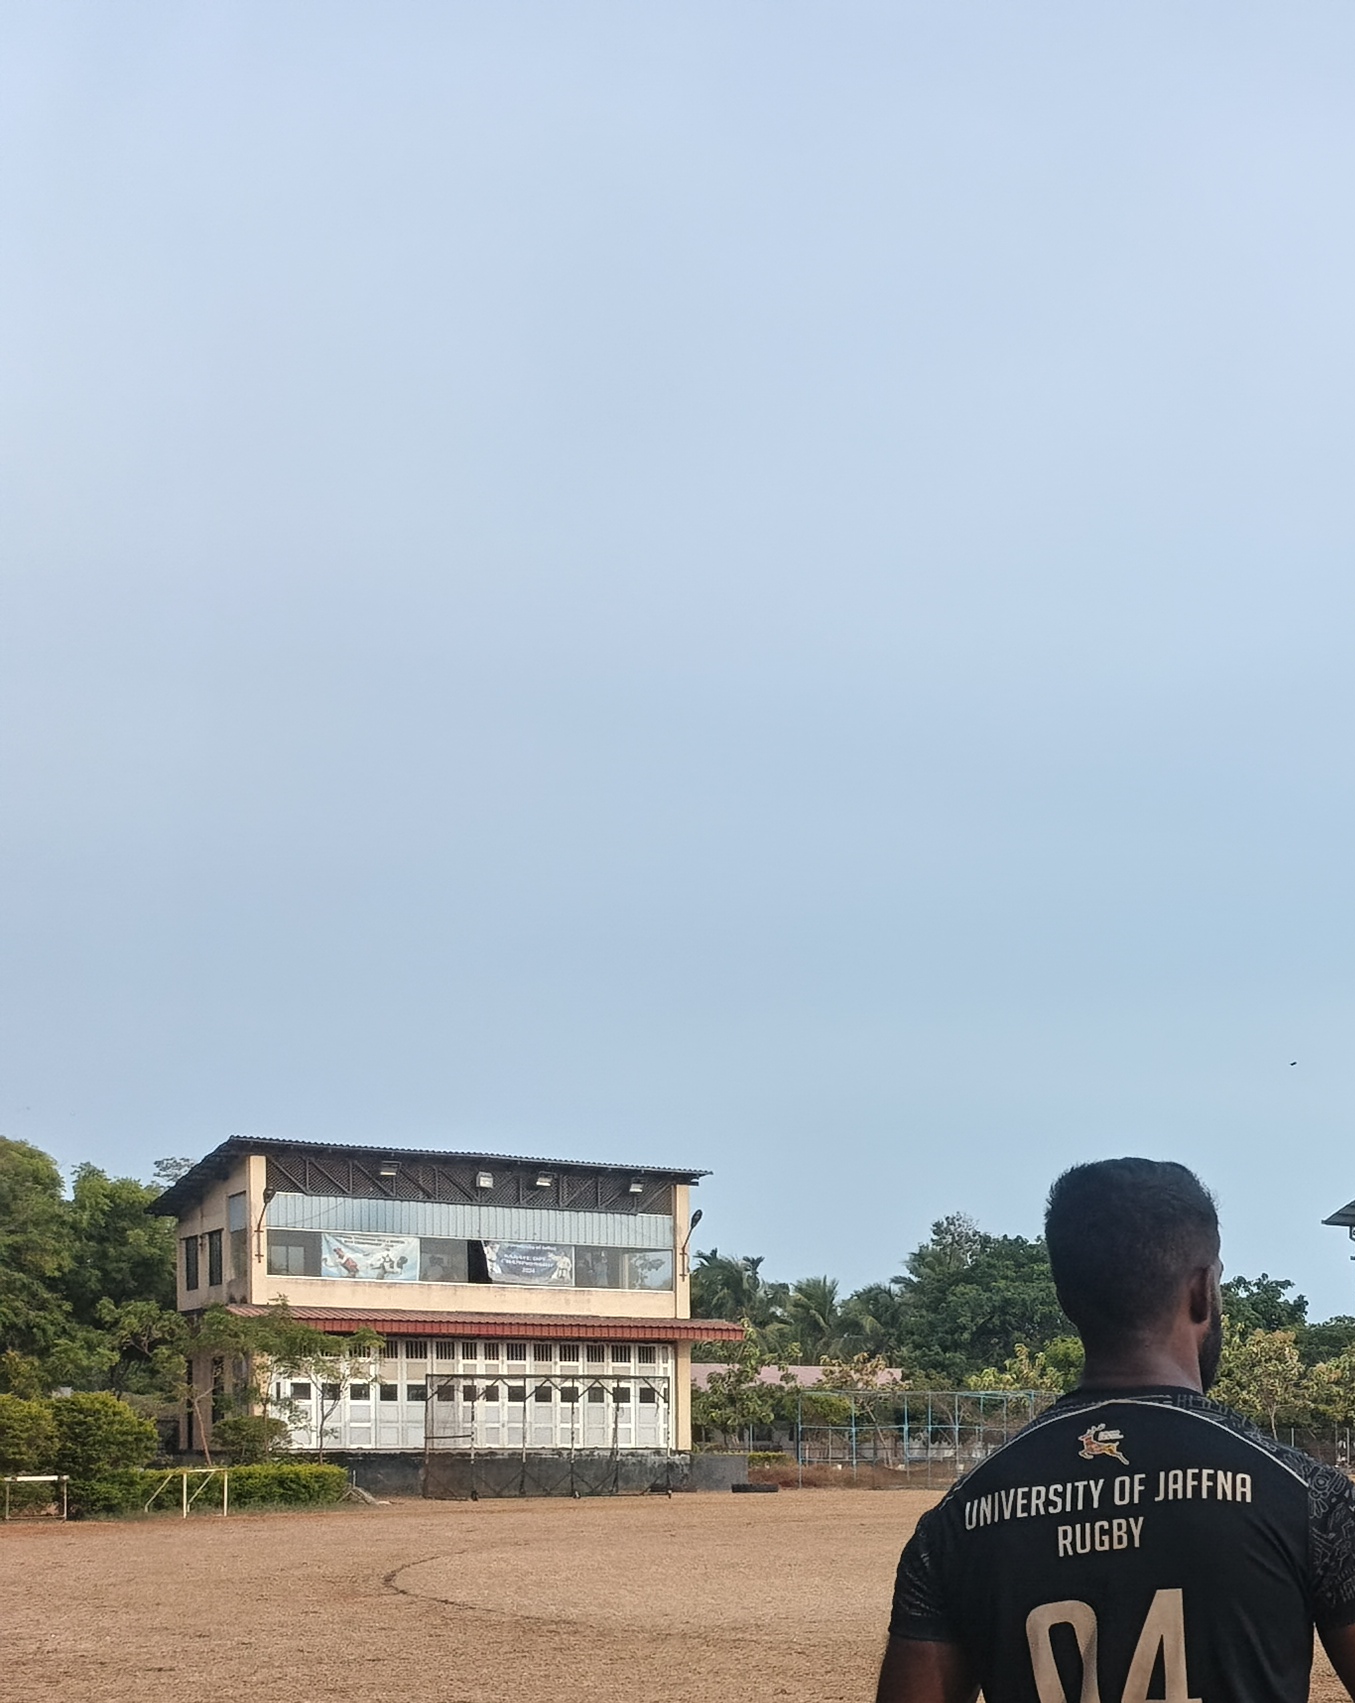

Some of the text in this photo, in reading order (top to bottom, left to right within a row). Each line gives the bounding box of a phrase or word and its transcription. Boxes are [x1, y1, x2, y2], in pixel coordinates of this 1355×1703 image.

[965, 1469, 1252, 1530] UNIVERSITY OF JAFFNA
[1058, 1517, 1144, 1557] RUGBY
